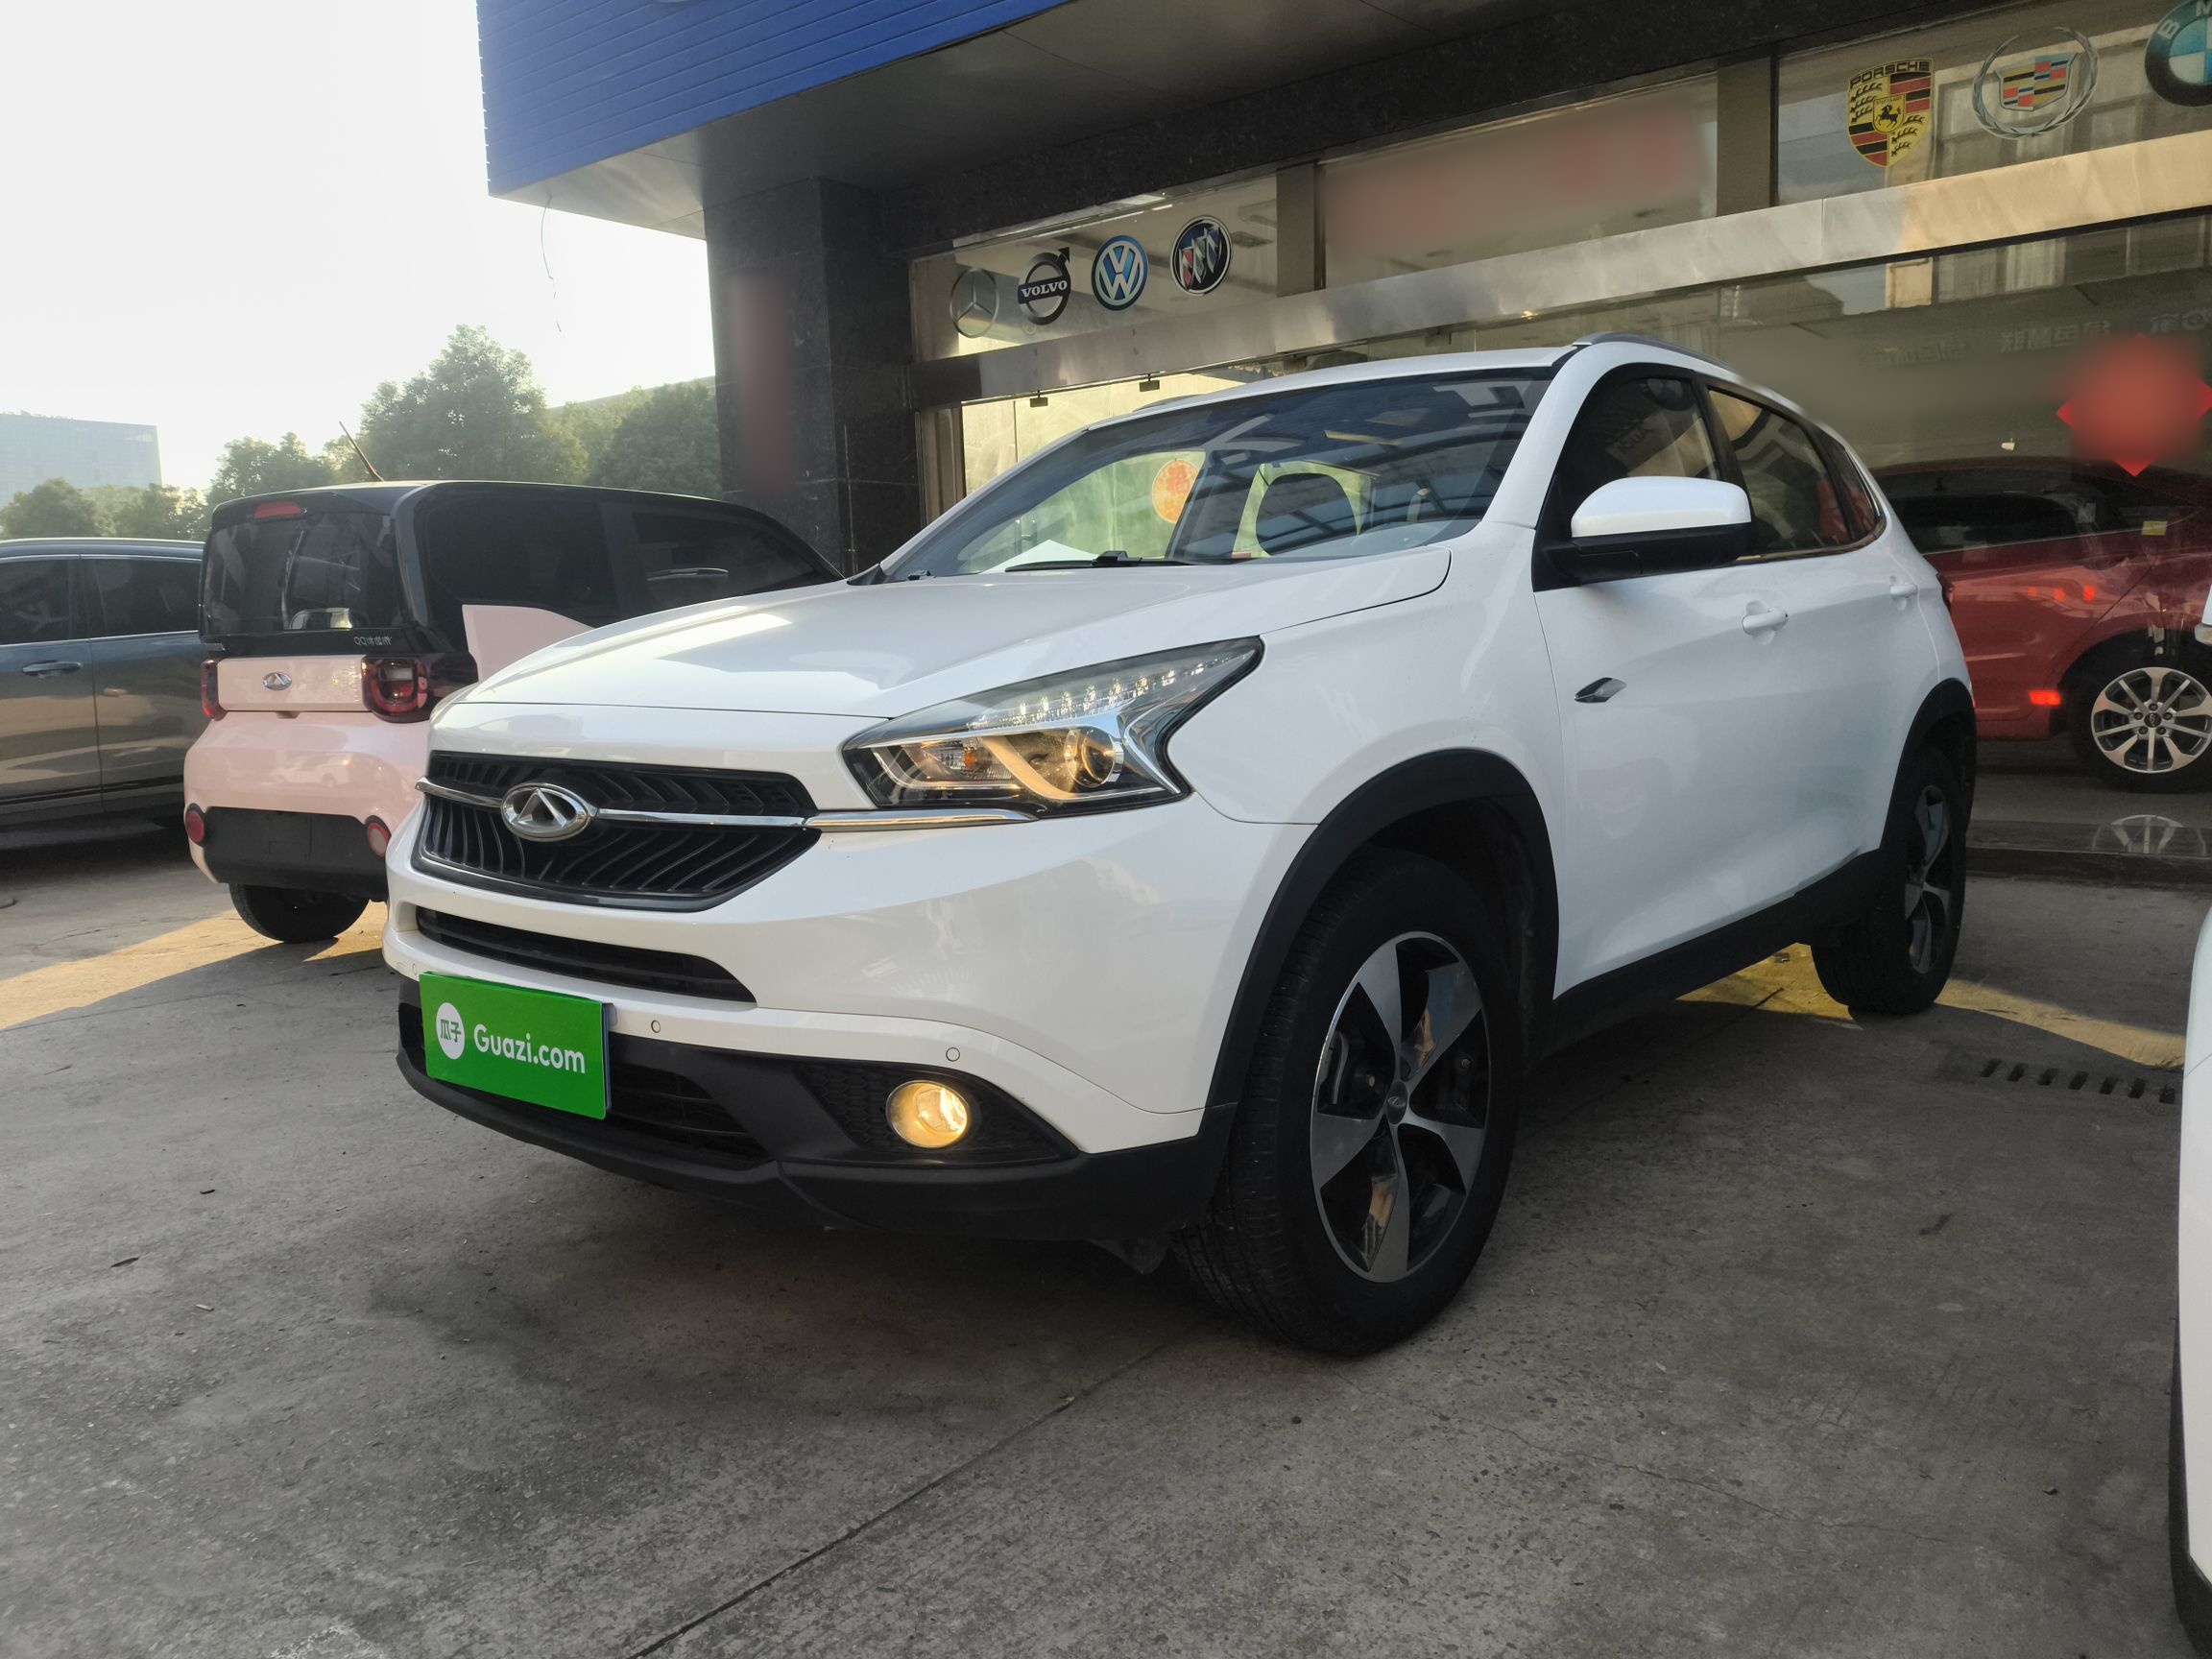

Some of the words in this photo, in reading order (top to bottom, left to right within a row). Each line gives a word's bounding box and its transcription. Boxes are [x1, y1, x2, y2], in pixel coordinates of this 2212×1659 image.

[1850, 60, 1930, 88] PORSCHE
[1021, 280, 1068, 299] VOLVO
[440, 1019, 462, 1043] 瓜子
[473, 1023, 586, 1074] Guazi.com
